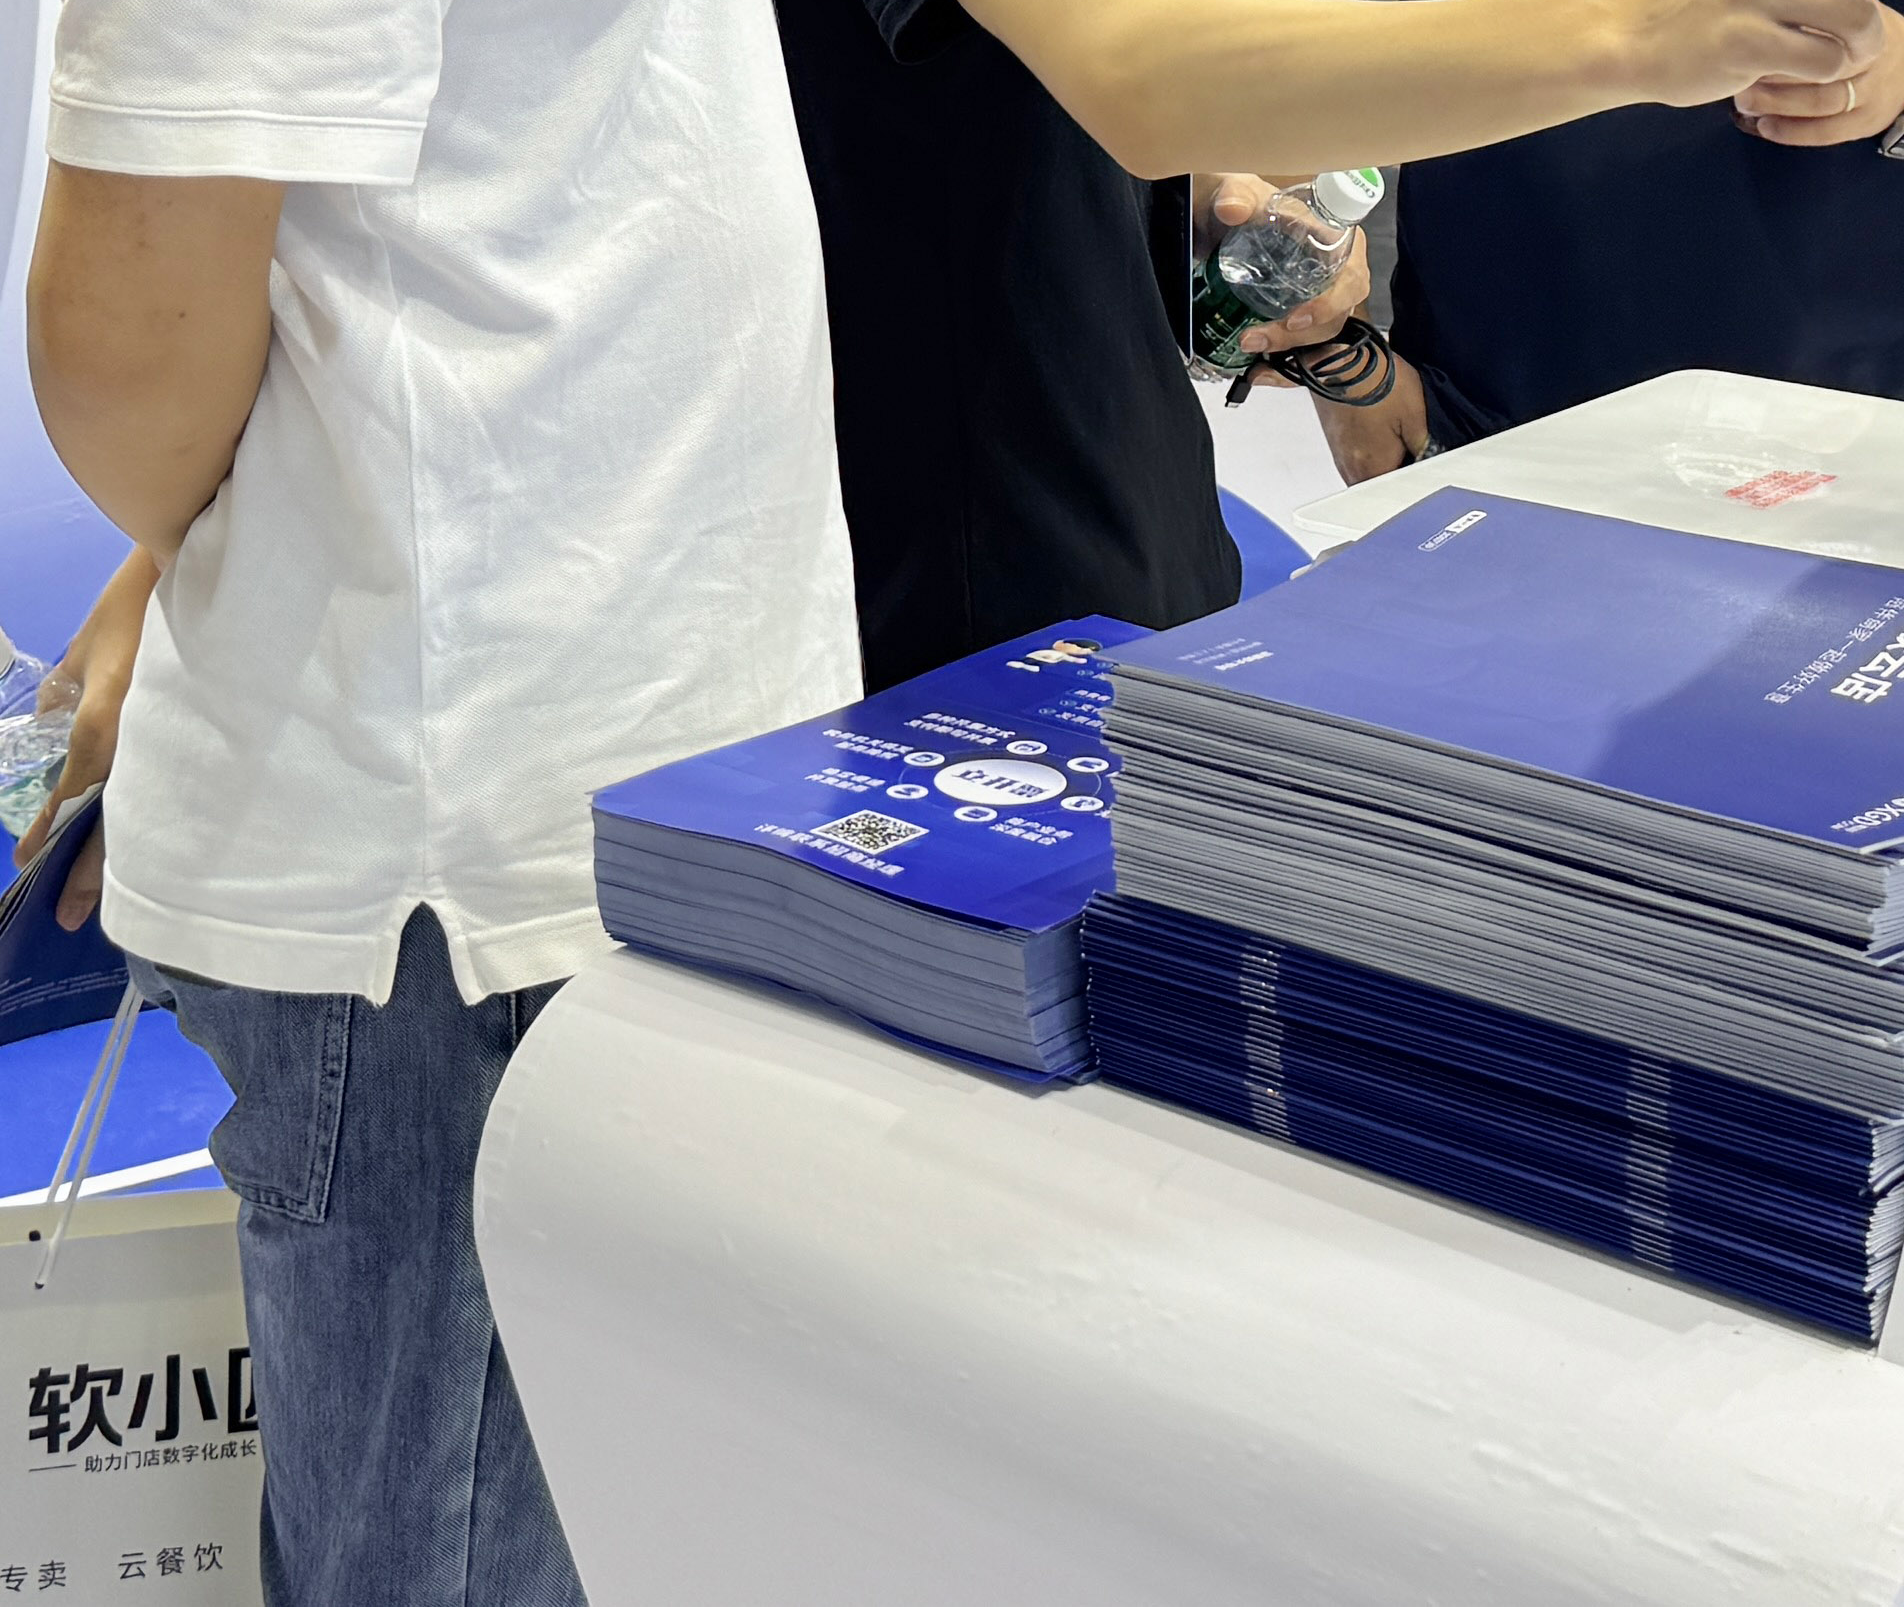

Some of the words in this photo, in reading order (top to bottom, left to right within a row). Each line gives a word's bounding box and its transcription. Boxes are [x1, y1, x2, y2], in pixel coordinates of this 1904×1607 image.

[84, 1438, 257, 1473] 助力门店数字化成长
[118, 1542, 224, 1581] 云餐饮
